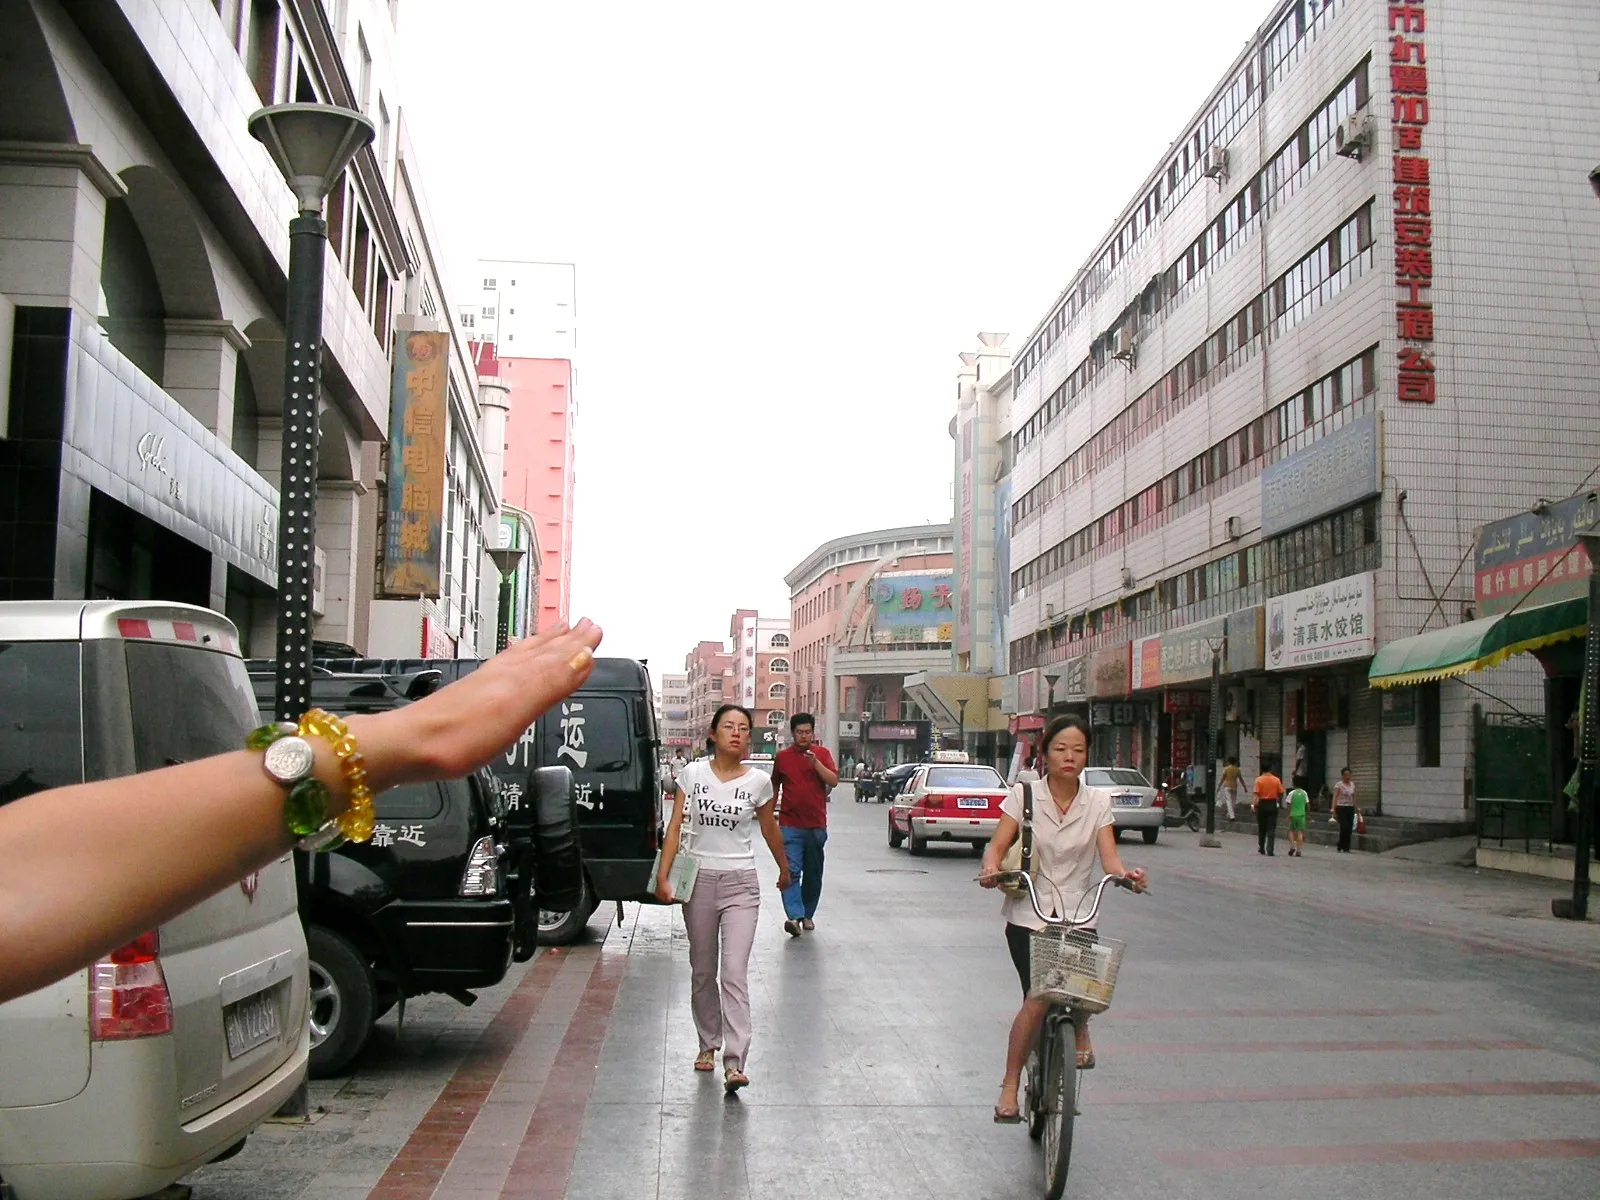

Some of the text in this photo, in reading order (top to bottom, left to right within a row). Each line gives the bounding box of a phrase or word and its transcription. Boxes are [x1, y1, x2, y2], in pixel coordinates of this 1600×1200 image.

[1293, 612, 1363, 647] 清真水饺馆
[1093, 703, 1134, 726] 复印
[693, 782, 753, 801] Re lax
[698, 798, 743, 816] Wear
[698, 813, 740, 831] Juicy
[371, 823, 427, 848] 靠近
